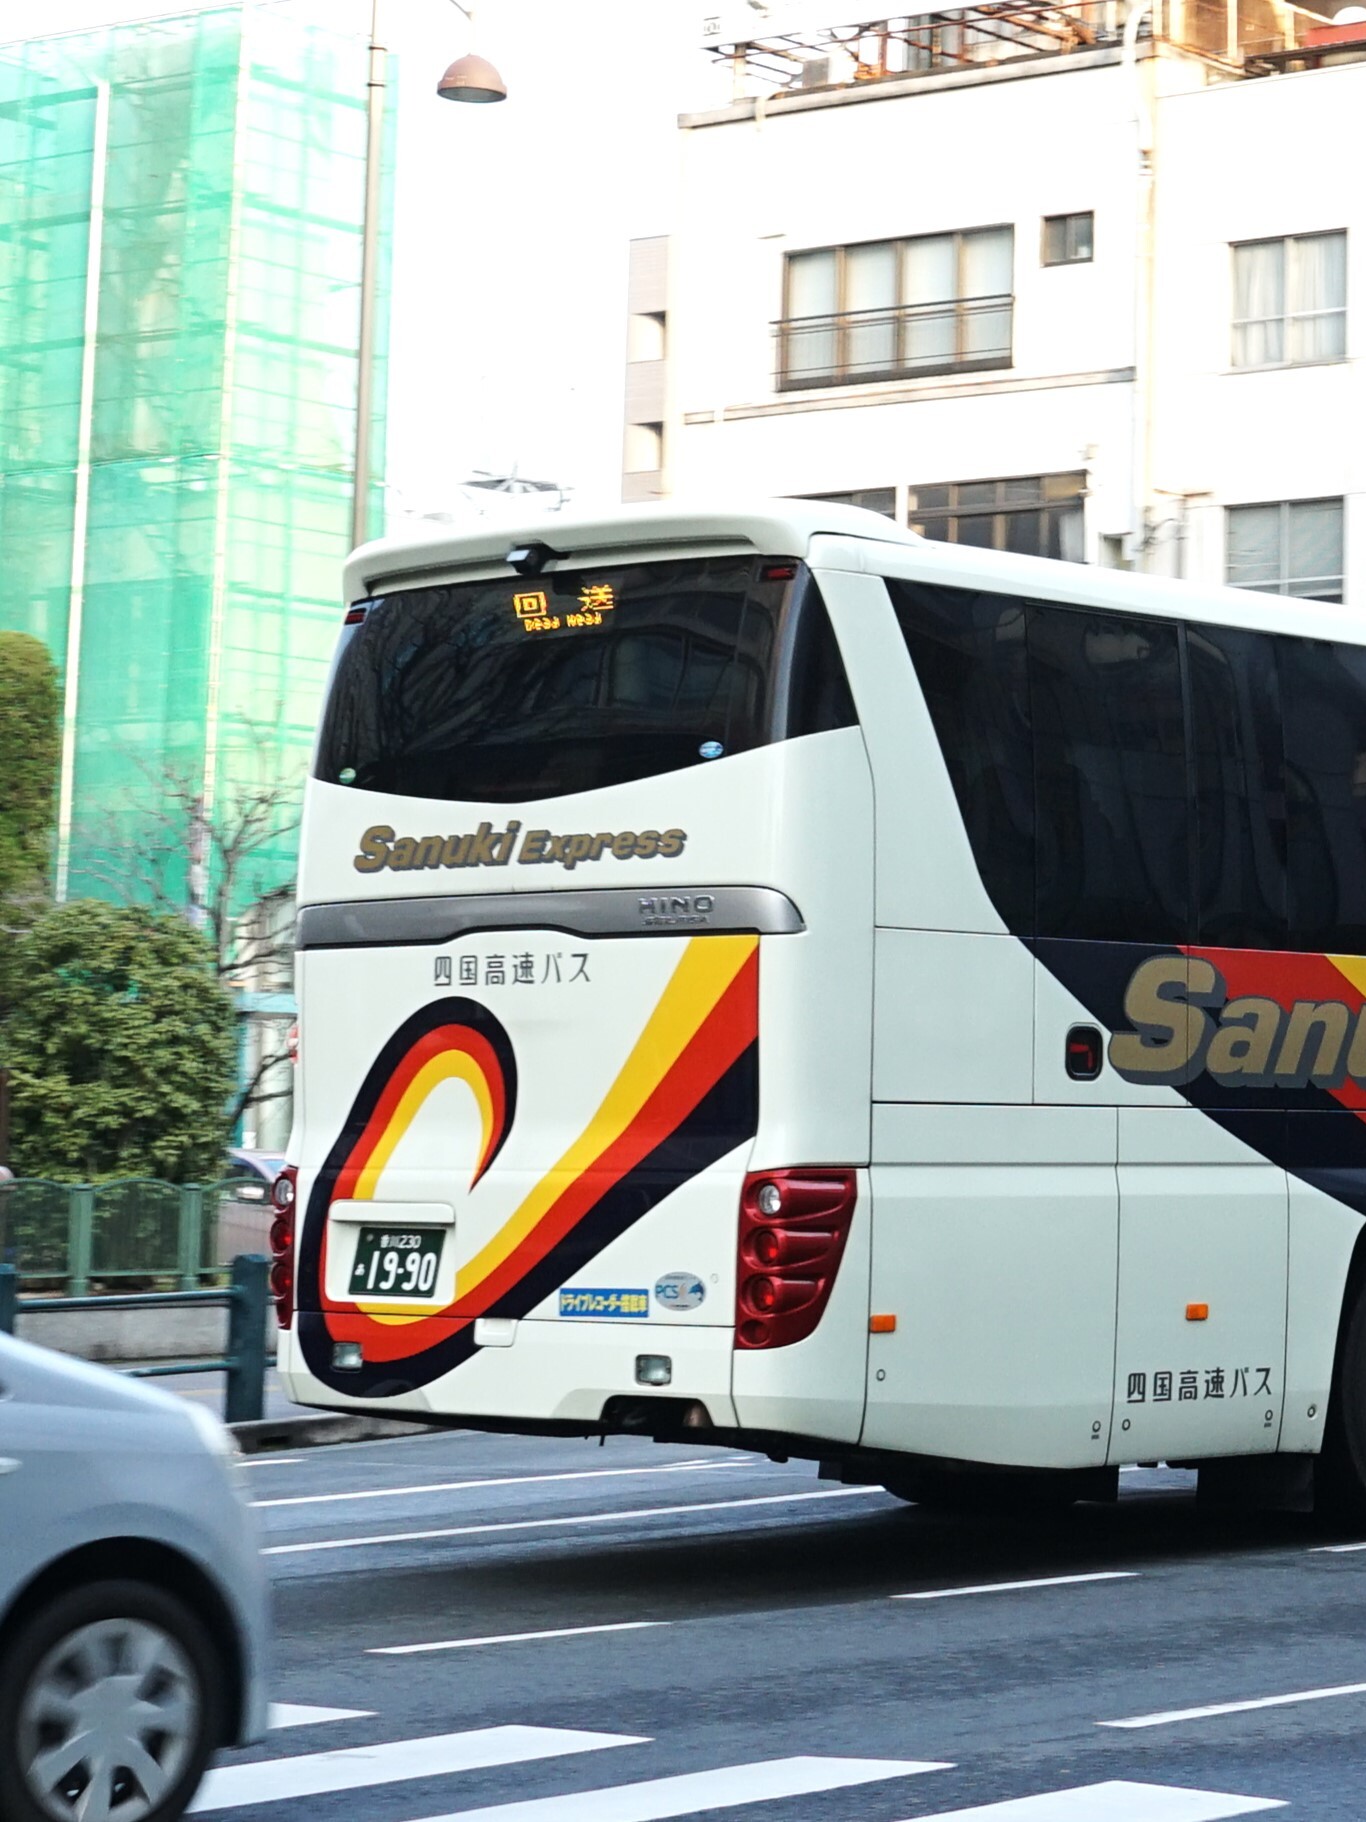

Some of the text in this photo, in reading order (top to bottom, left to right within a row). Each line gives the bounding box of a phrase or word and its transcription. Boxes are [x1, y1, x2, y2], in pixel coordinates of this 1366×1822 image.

[513, 585, 614, 618] 回送
[354, 820, 688, 873] Sanuki Express
[638, 895, 714, 913] HINO
[433, 952, 592, 987] 四国高速バス
[366, 1250, 437, 1291] 19-90
[655, 1284, 680, 1299] PCS
[1127, 1367, 1272, 1403] 四国高速バス
